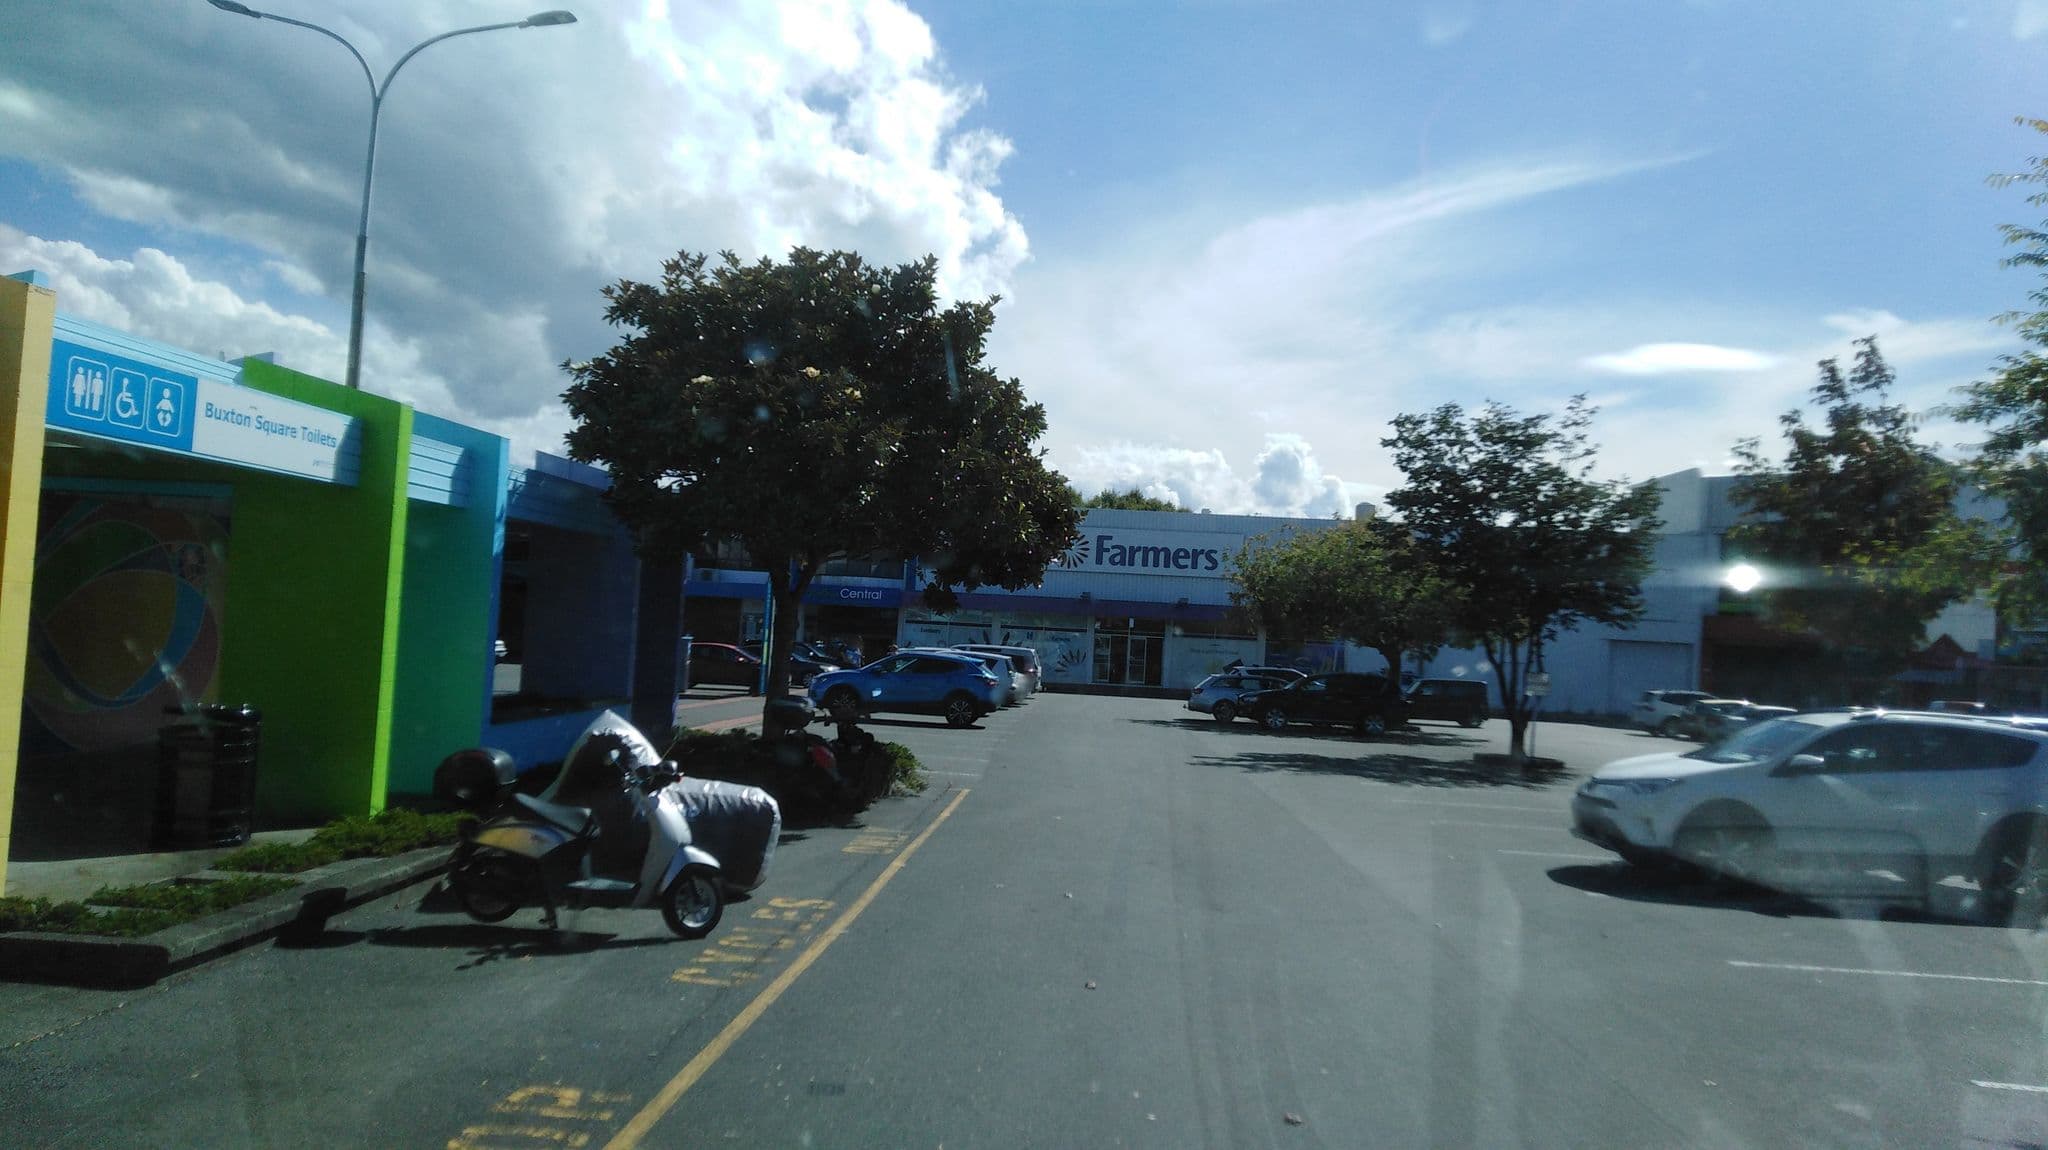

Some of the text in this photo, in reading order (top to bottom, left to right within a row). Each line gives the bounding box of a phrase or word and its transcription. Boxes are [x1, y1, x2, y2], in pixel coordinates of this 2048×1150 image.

[204, 402, 337, 448] Buxton Square Toilets
[1095, 535, 1219, 571] Farmers
[840, 588, 882, 600] Central
